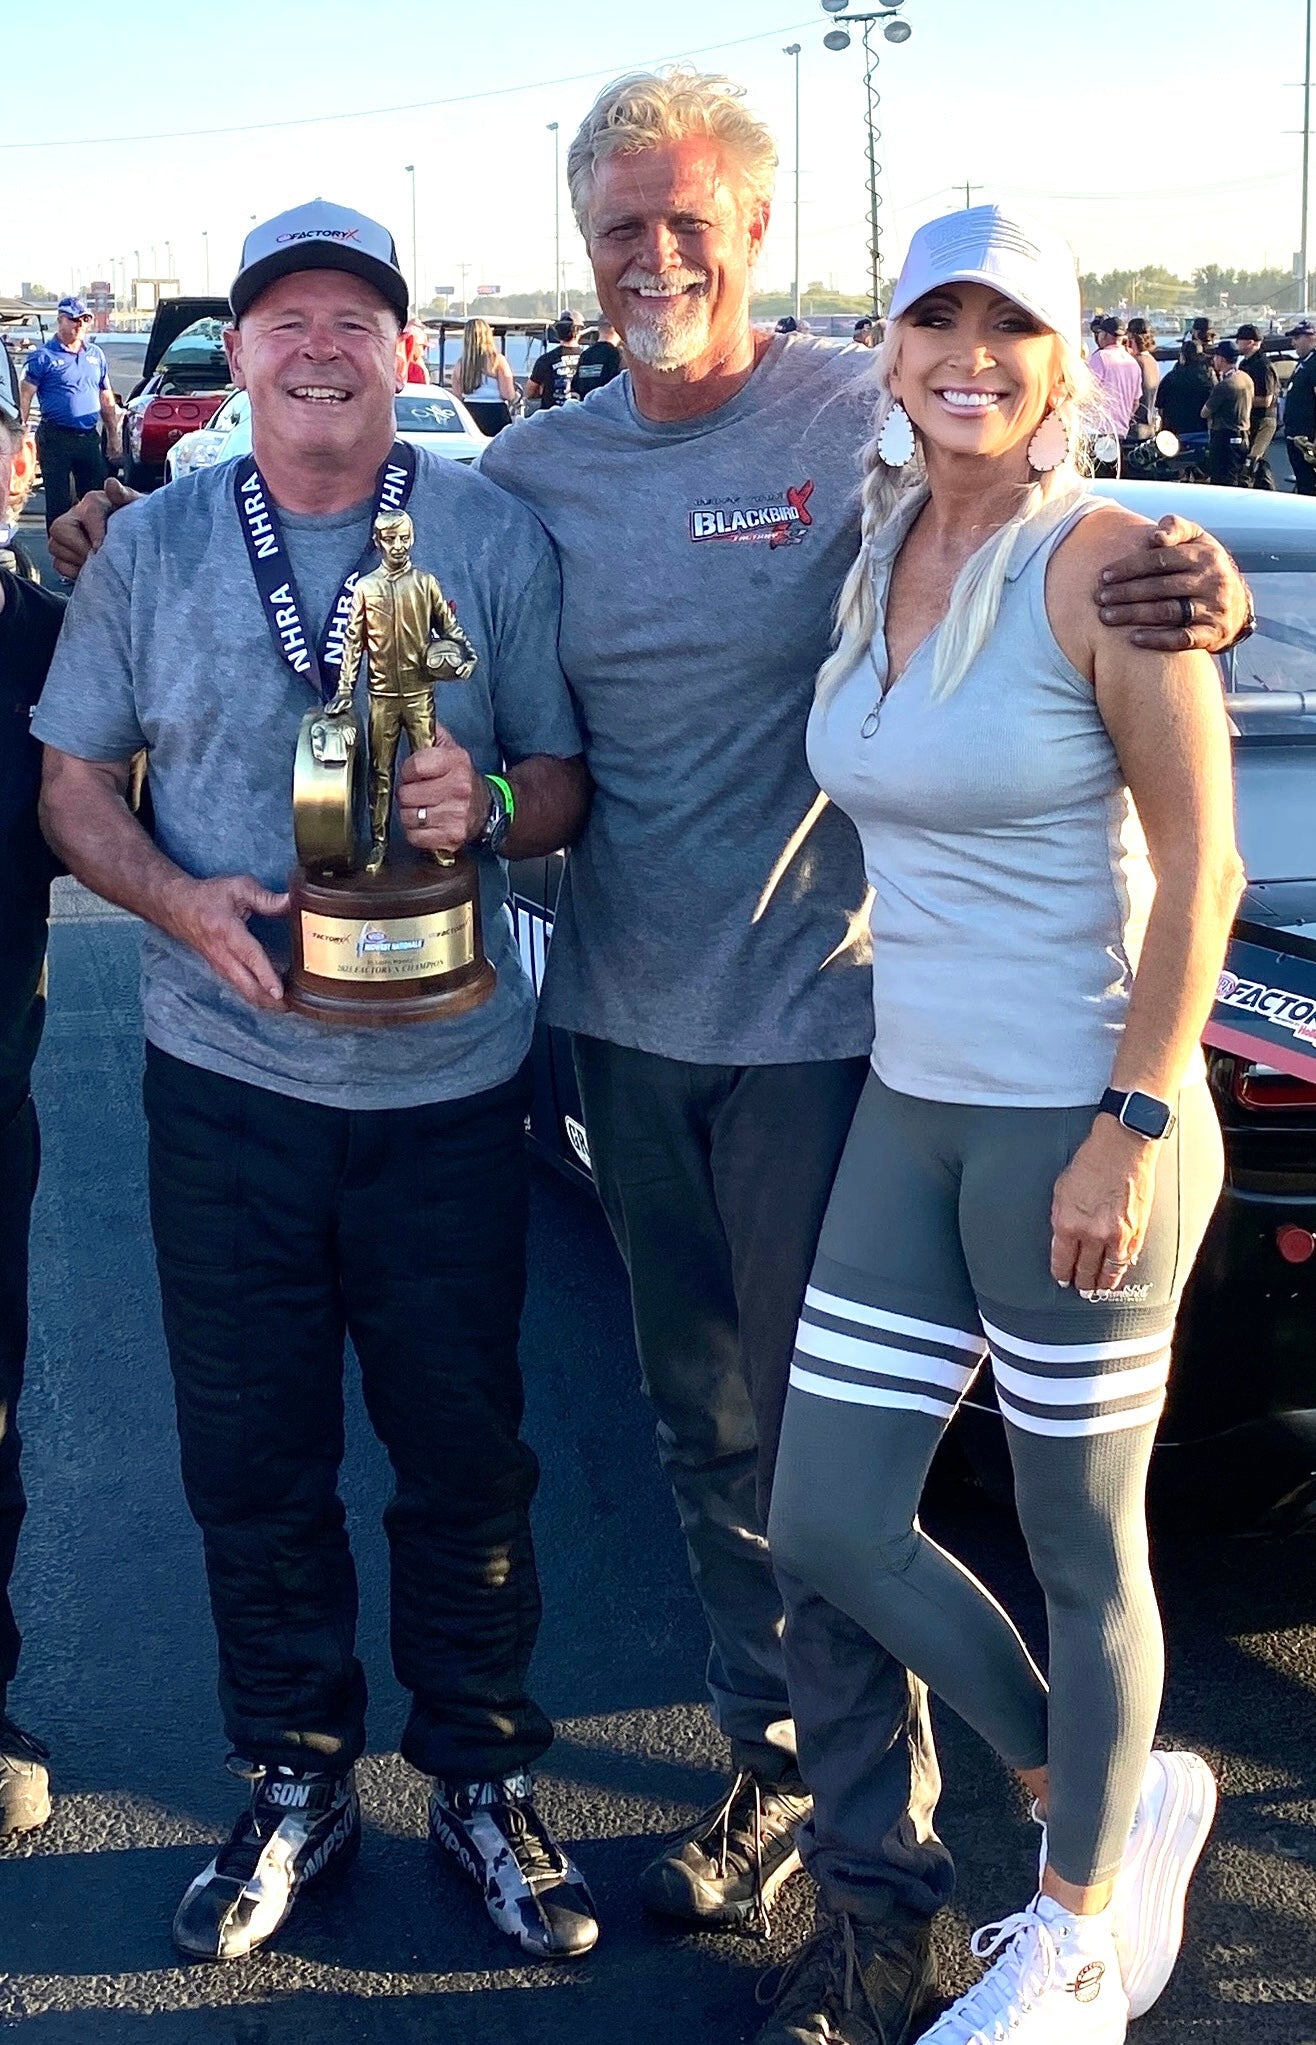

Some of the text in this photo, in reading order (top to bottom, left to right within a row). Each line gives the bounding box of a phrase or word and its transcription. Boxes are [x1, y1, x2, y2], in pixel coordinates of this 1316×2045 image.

[241, 471, 279, 559] NHRA
[693, 506, 800, 538] BLACKBIRD
[269, 583, 311, 673] NHRA
[266, 1783, 310, 1807] SON
